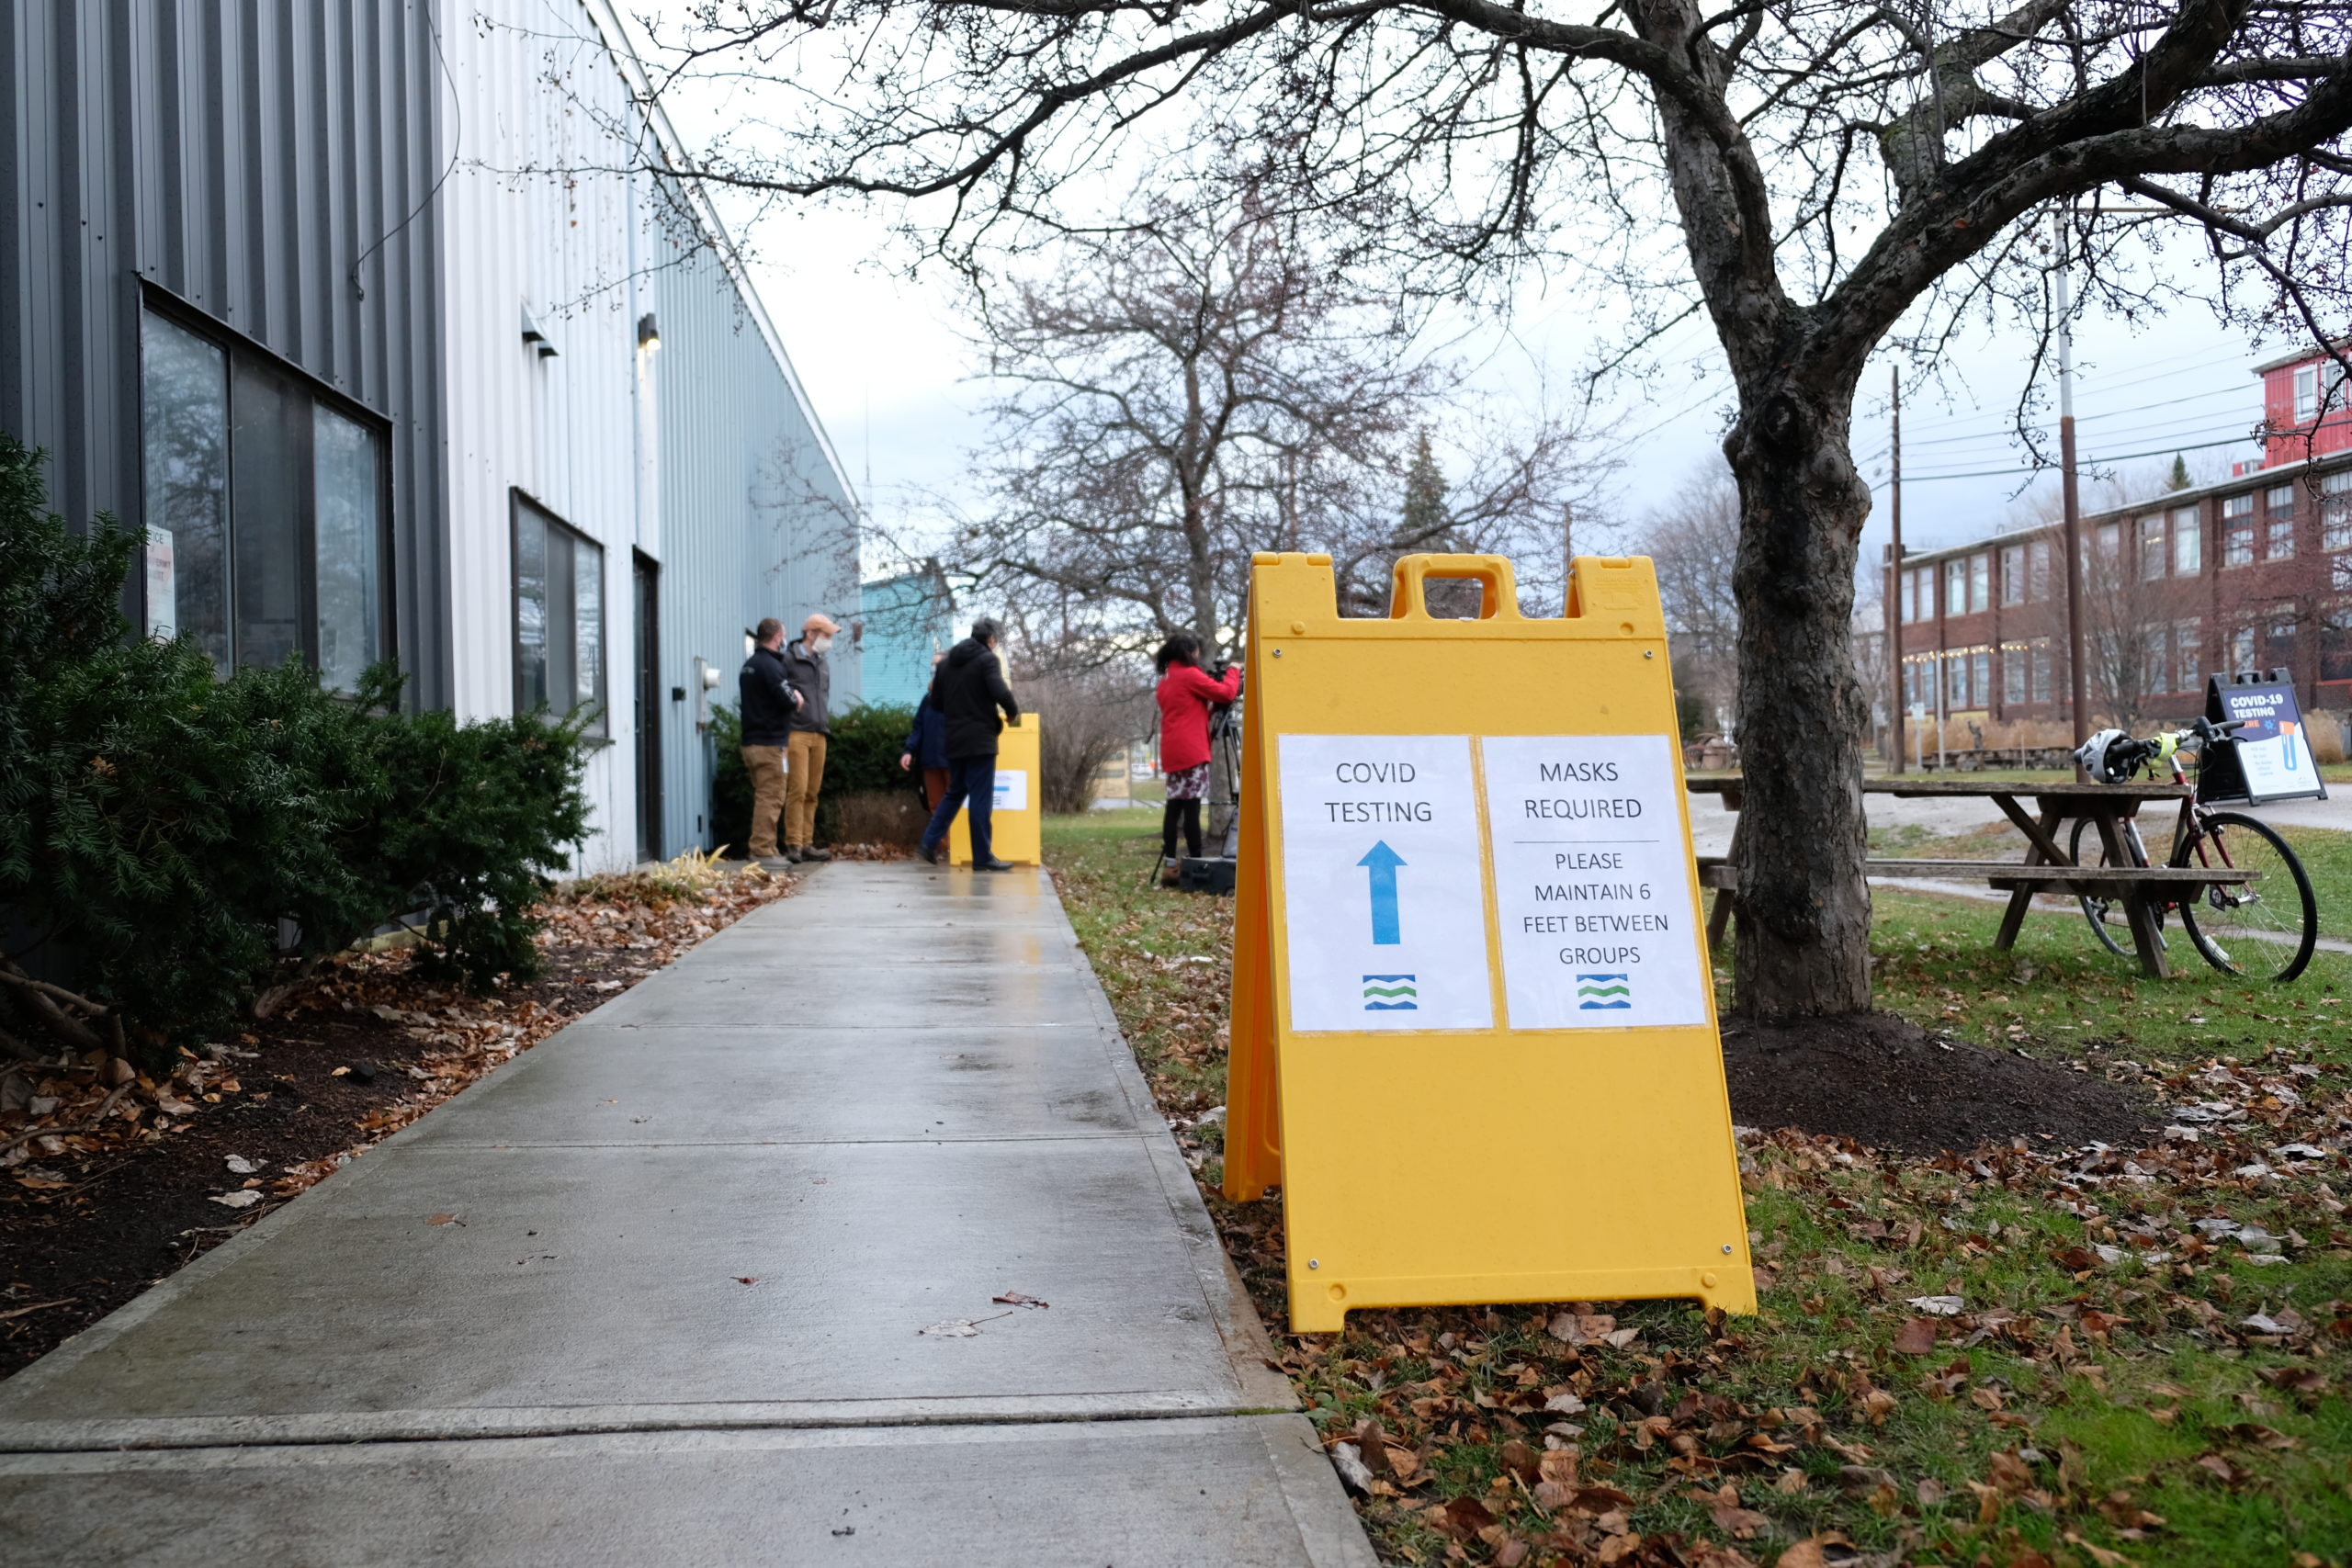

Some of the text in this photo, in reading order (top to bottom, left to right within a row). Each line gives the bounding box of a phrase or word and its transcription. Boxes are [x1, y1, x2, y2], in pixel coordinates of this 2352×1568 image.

[2231, 694, 2283, 707] COVID-19
[2233, 706, 2275, 719] TESTING
[1336, 761, 1416, 784] COVID
[1539, 761, 1619, 783] MASKS
[1323, 801, 1432, 823] TESTING
[1524, 798, 1643, 821] REQUIRED
[1555, 852, 1624, 871] PLEASE
[1534, 883, 1652, 902] MAINTAIN 6
[1523, 913, 1669, 934] FEET BETWEEN
[1559, 946, 1641, 965] GROUPS
